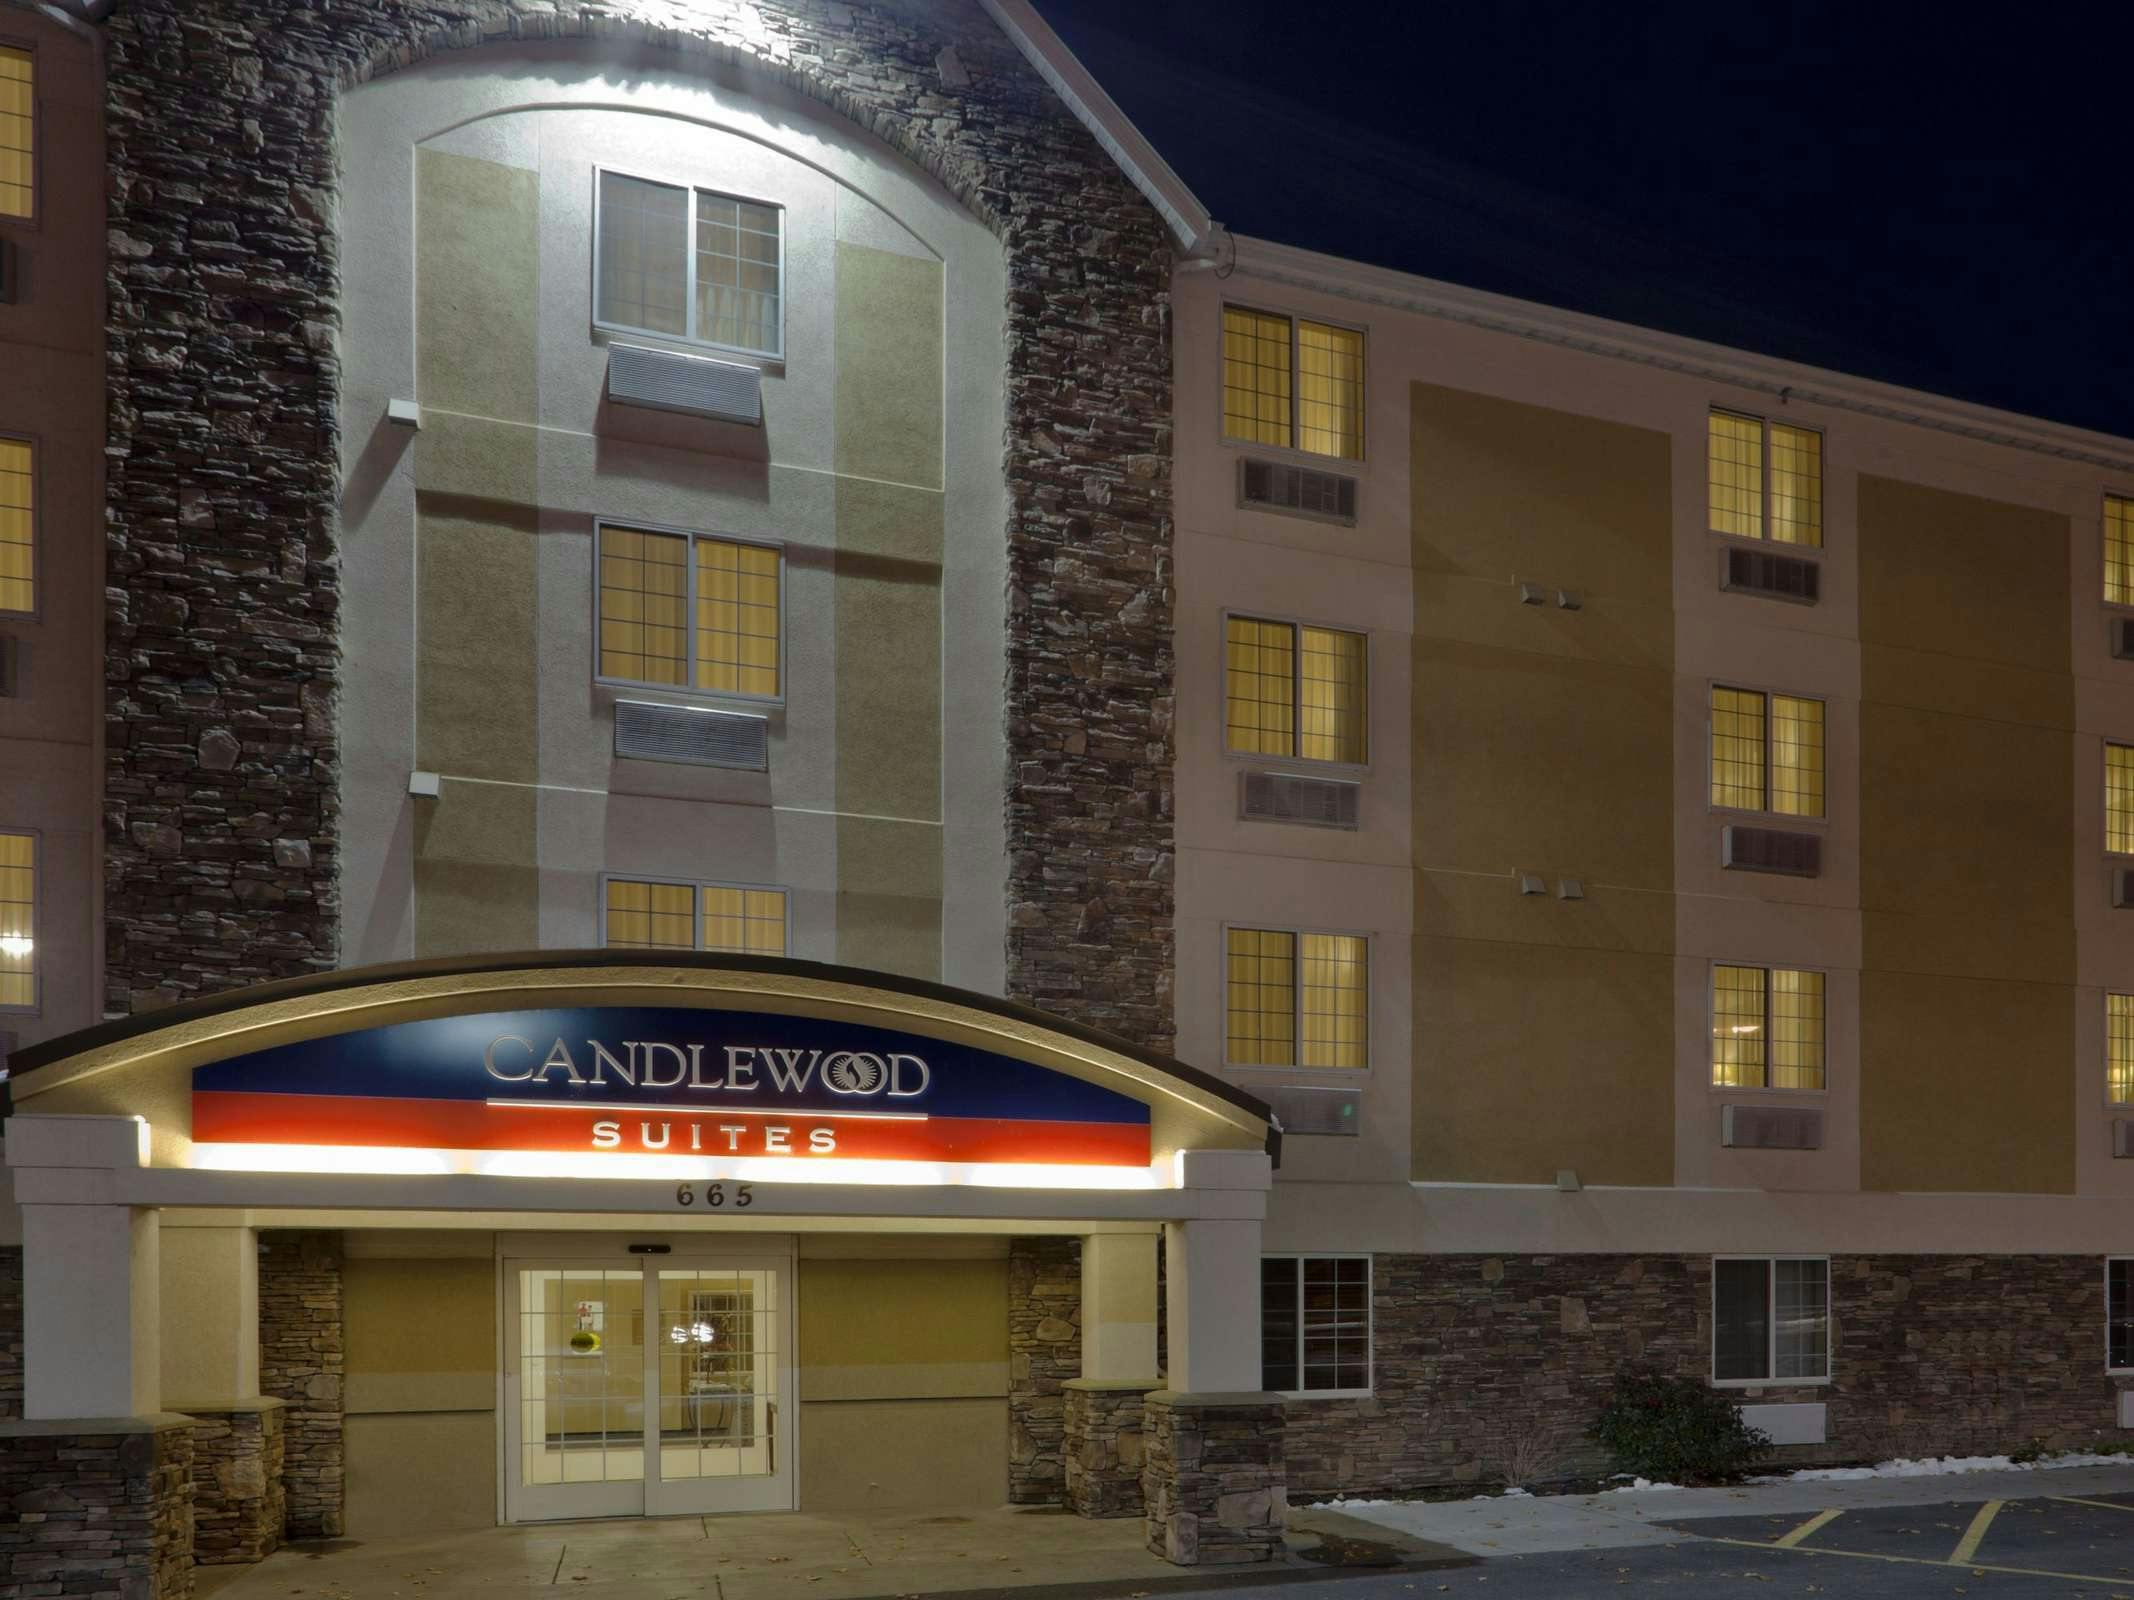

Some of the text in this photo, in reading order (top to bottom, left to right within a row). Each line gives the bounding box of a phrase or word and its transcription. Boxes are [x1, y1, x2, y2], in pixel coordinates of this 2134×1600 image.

[485, 1034, 931, 1096] CANDLEWOOD
[591, 1121, 837, 1153] SUITES
[676, 1183, 754, 1207] 665
